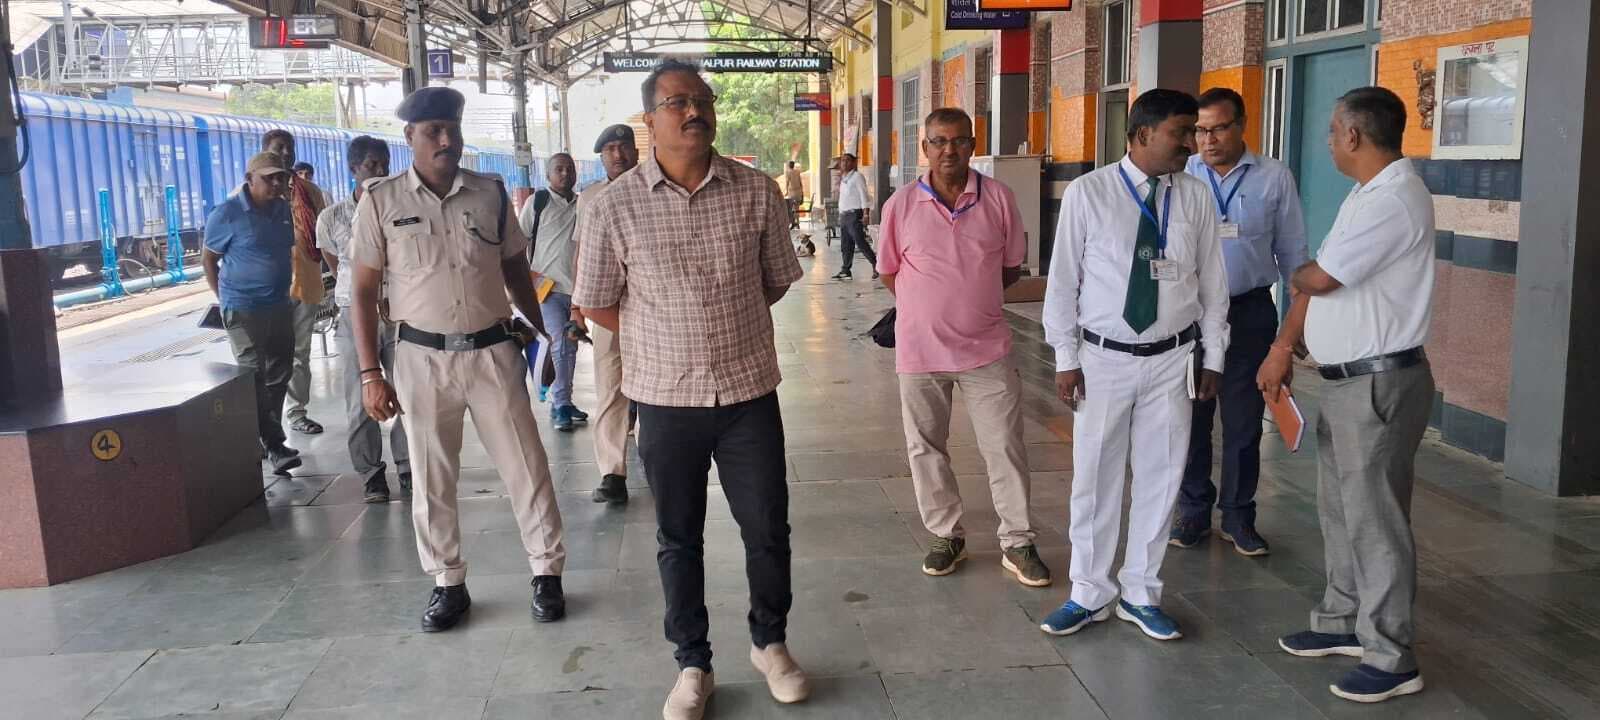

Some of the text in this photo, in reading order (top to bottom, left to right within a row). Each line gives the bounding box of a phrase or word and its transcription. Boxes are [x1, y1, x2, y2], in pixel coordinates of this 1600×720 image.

[293, 18, 318, 34] ER
[434, 55, 443, 72] 1
[736, 58, 778, 68] RAILWAY
[780, 58, 820, 68] STATION
[98, 434, 116, 454] 4
